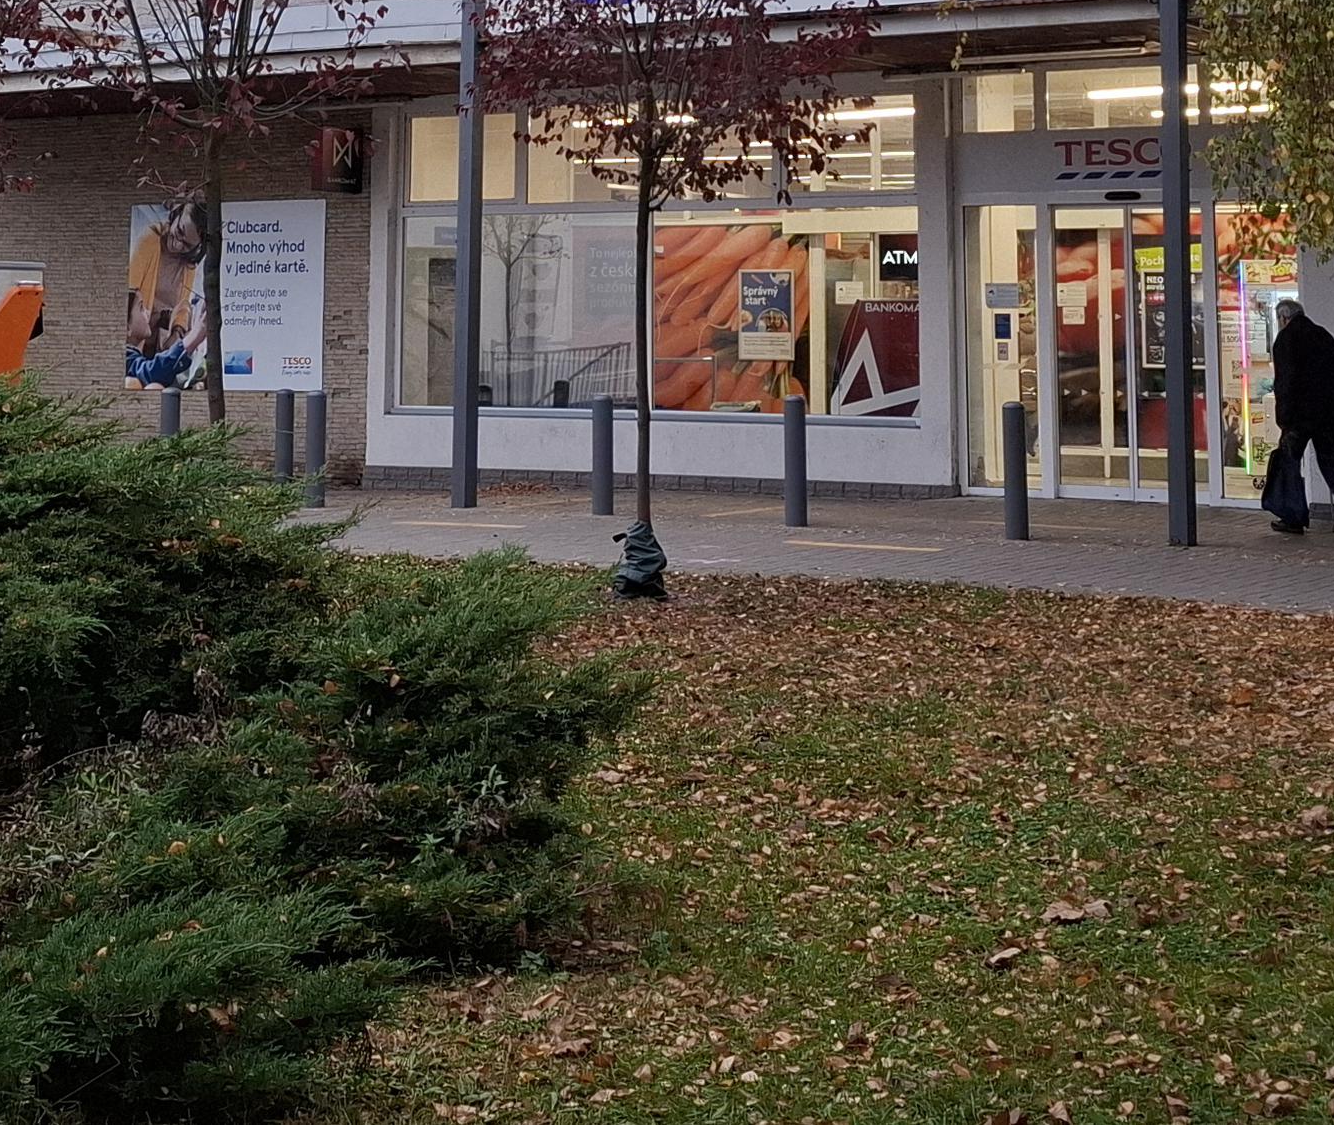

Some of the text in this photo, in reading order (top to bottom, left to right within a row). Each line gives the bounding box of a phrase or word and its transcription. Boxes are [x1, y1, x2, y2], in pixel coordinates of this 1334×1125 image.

[1055, 138, 1191, 166] TESC
[227, 220, 283, 233] Clubcard.
[227, 239, 305, 256] Mnoho výhod
[882, 250, 918, 265] ATM
[226, 259, 309, 277] v jediné kartě.
[601, 262, 637, 278] česk
[224, 288, 288, 300] Zaregistrujte se
[743, 286, 778, 298] Správný
[745, 296, 766, 305] start
[231, 302, 265, 313] čerpejte
[267, 302, 281, 312] své
[865, 302, 920, 313] BANKOMA
[224, 316, 283, 328] odměny ihned.
[282, 357, 311, 365] TESCO
